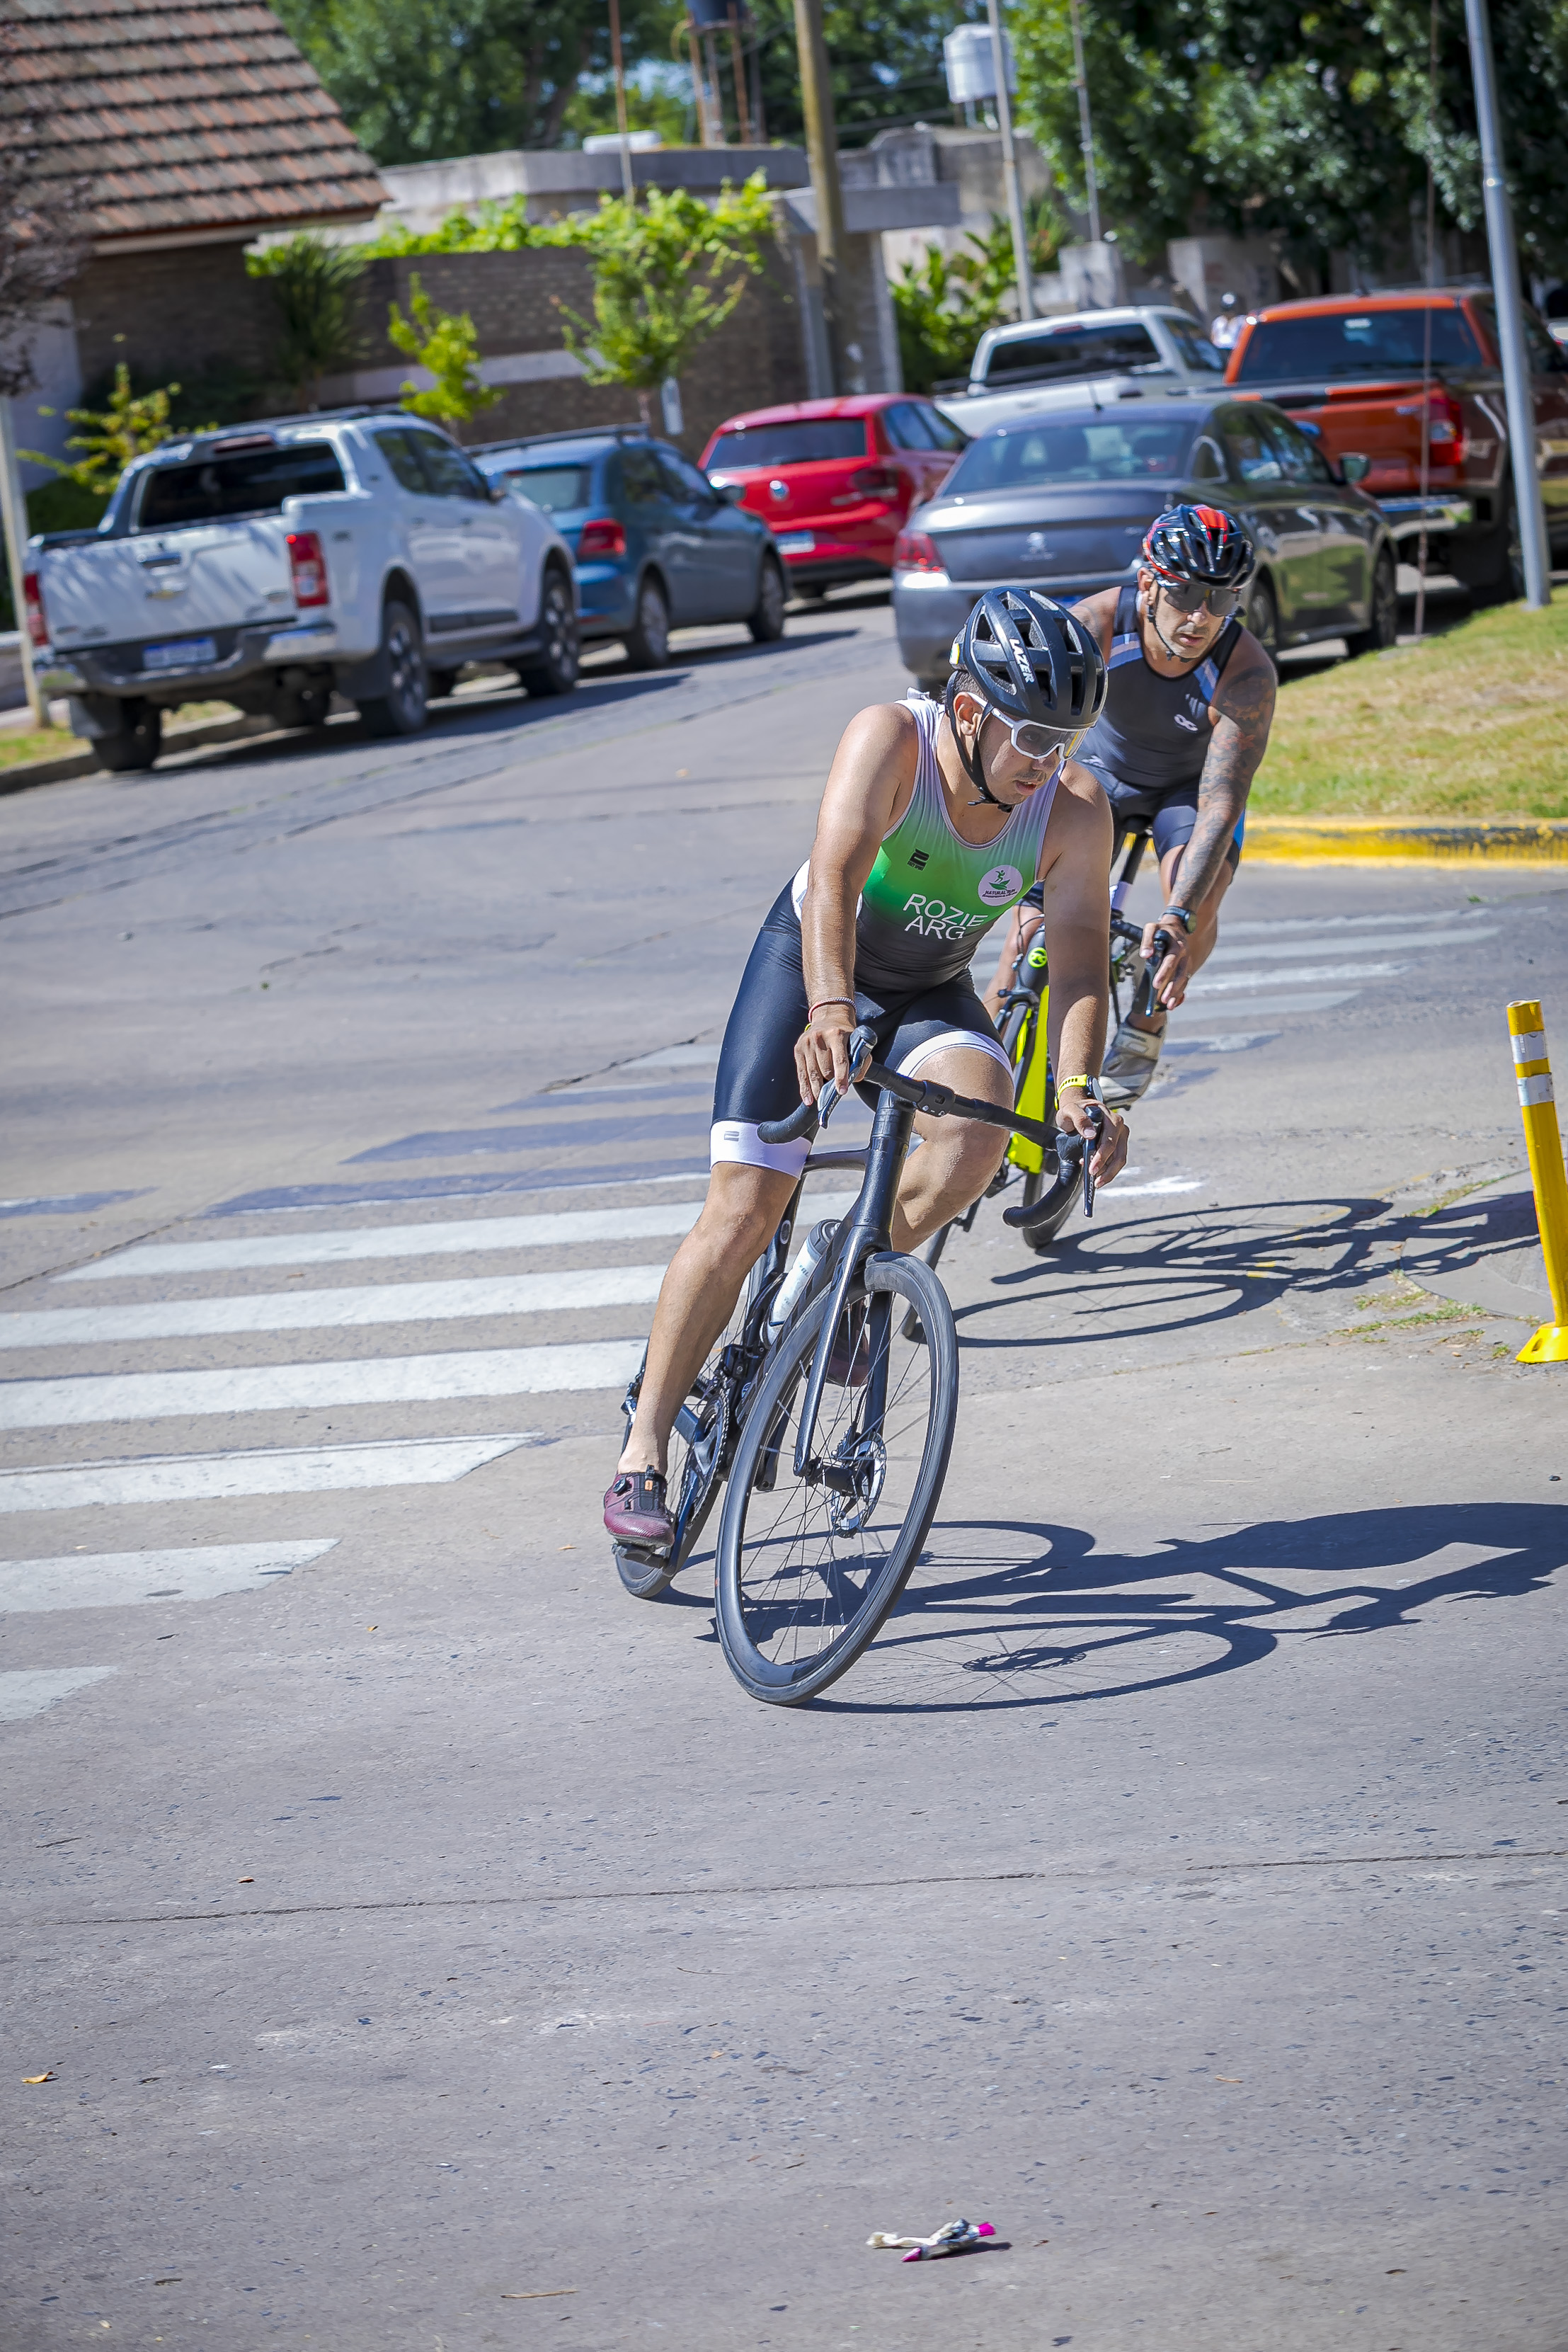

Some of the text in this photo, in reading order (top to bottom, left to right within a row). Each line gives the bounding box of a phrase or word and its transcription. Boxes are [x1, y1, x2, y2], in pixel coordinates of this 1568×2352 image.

[1009, 638, 1035, 684] LAZER
[903, 894, 988, 927] ROZIE
[904, 915, 966, 940] ARG
